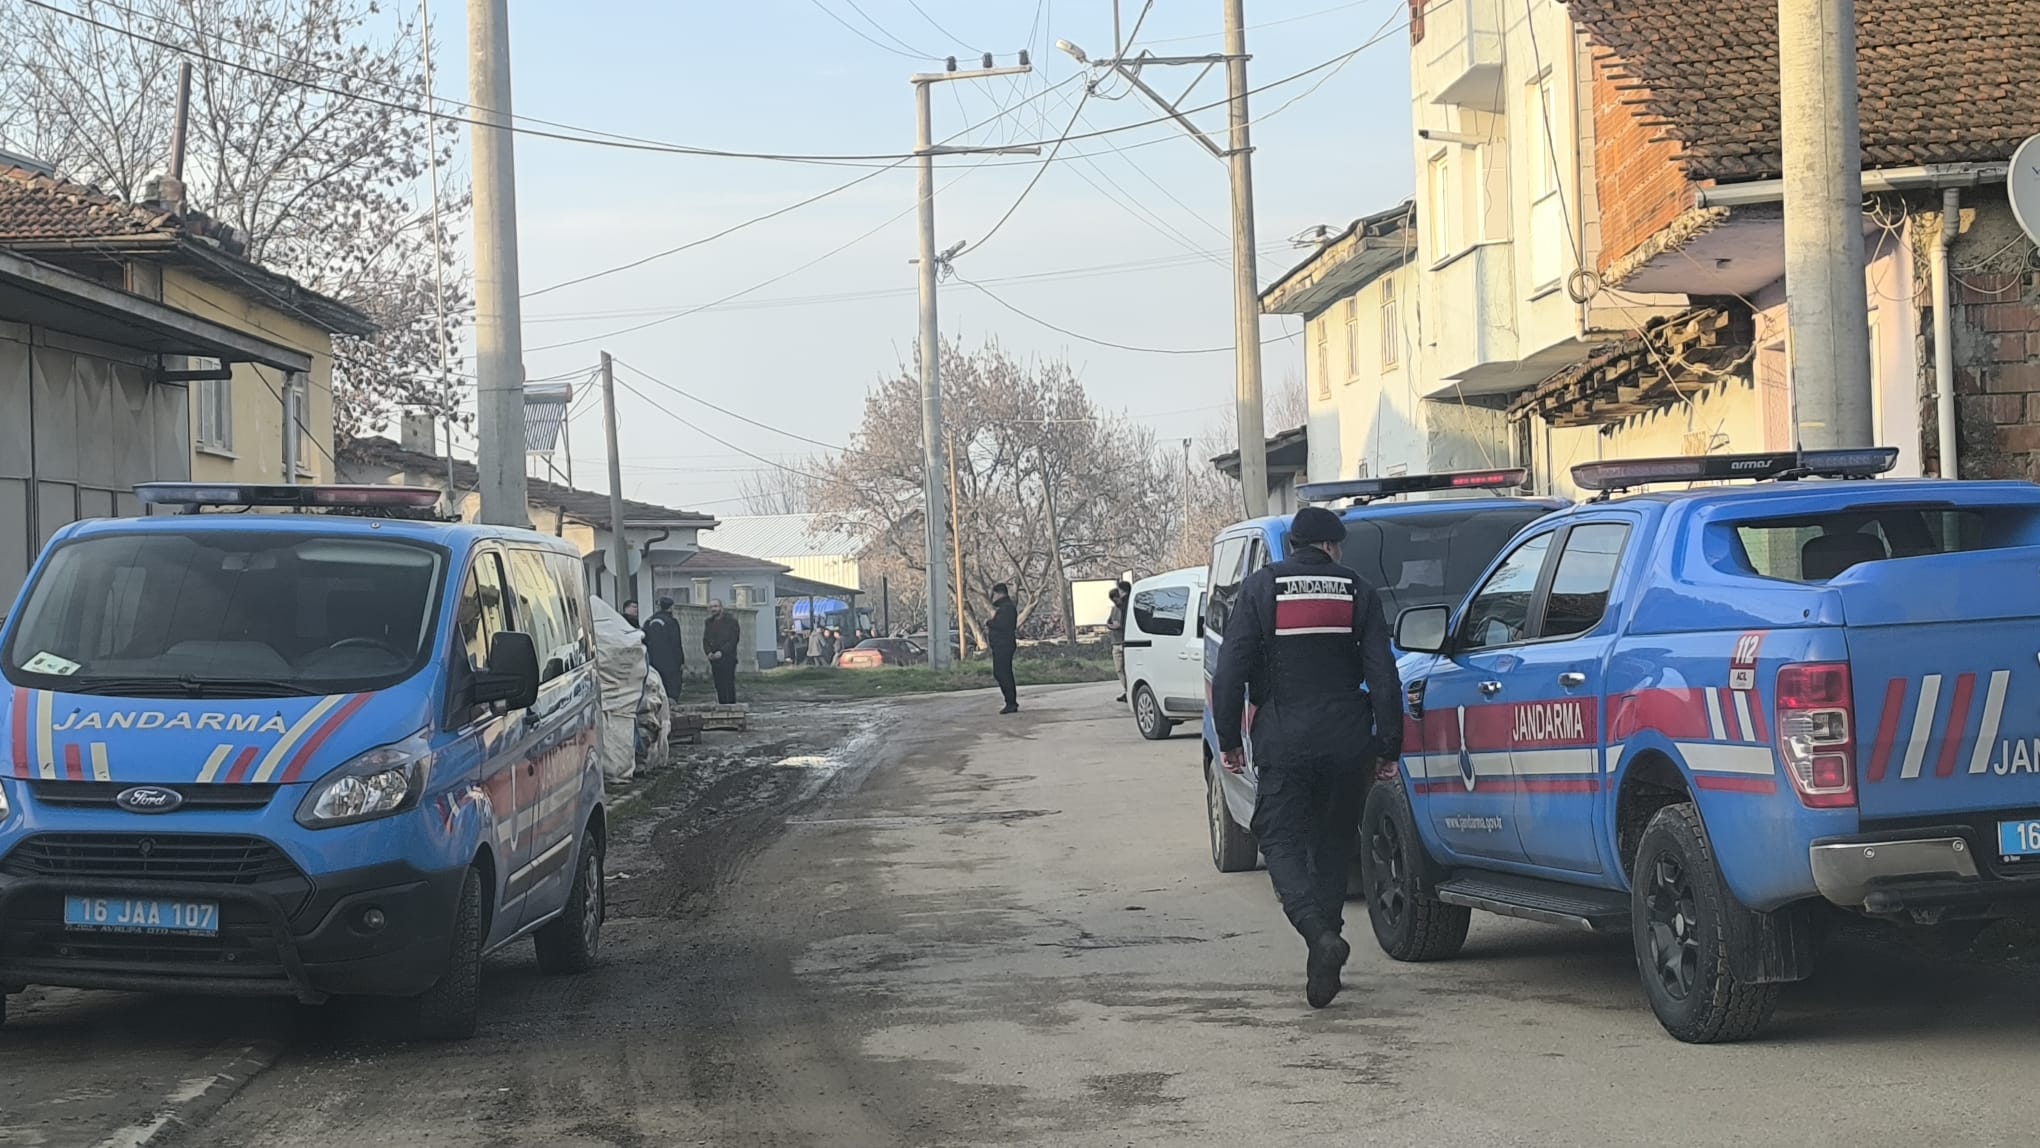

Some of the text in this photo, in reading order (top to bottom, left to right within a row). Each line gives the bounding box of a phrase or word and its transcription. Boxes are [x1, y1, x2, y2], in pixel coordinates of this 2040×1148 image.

[1284, 581, 1348, 595] JANDARMA
[1735, 635, 1760, 665] 112
[53, 711, 287, 733] JANDARMA
[1512, 702, 1585, 742] JANDARMA
[130, 789, 167, 806] Ford
[82, 898, 214, 928] 16 JAA 107
